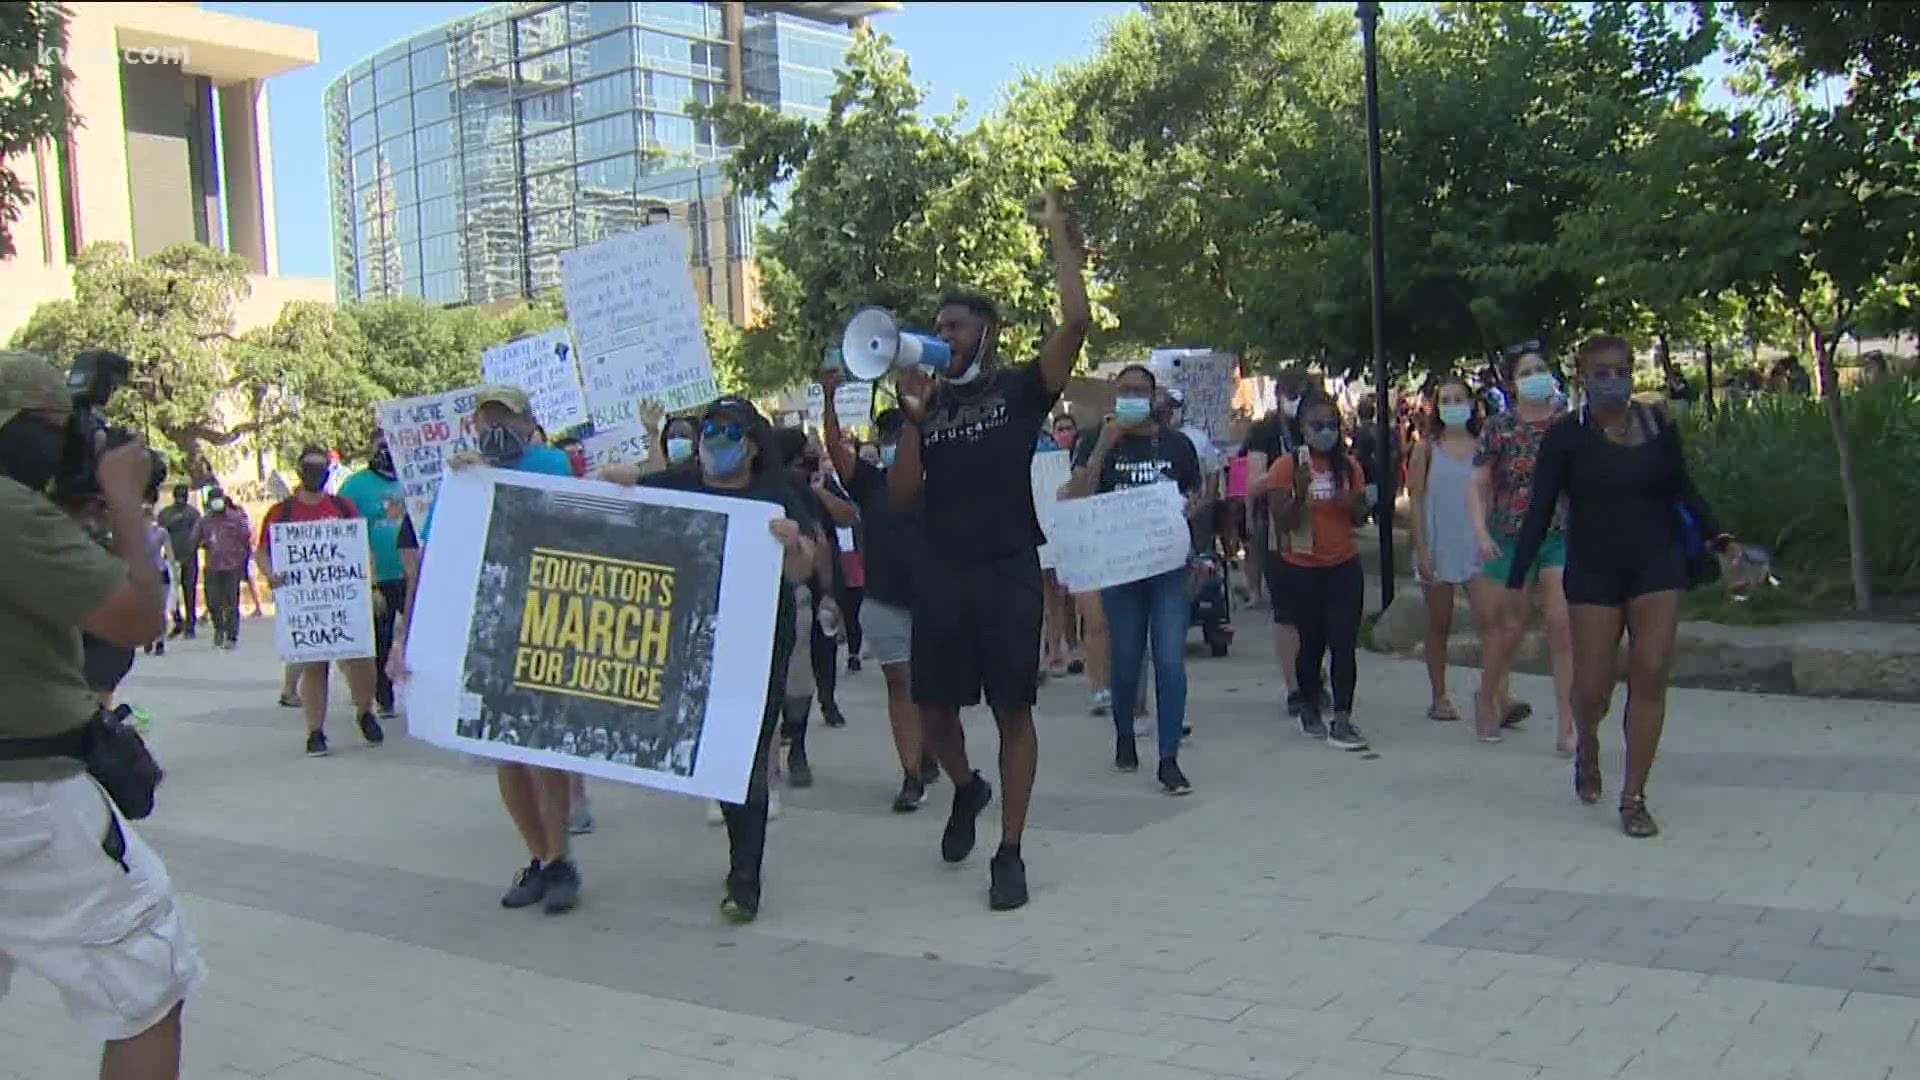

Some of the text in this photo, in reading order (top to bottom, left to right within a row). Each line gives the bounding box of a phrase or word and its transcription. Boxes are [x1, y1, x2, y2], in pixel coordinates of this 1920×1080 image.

[274, 526, 281, 543] I
[287, 541, 346, 565] BLACK
[308, 562, 368, 583] VERBAL
[528, 552, 675, 608] EDUCATOR'S
[289, 583, 359, 605] STUDENTS
[287, 608, 348, 630] HEAR ME
[518, 587, 672, 667] MARCH
[291, 626, 356, 650] ROAR
[512, 645, 664, 701] FOR JUSTICE
